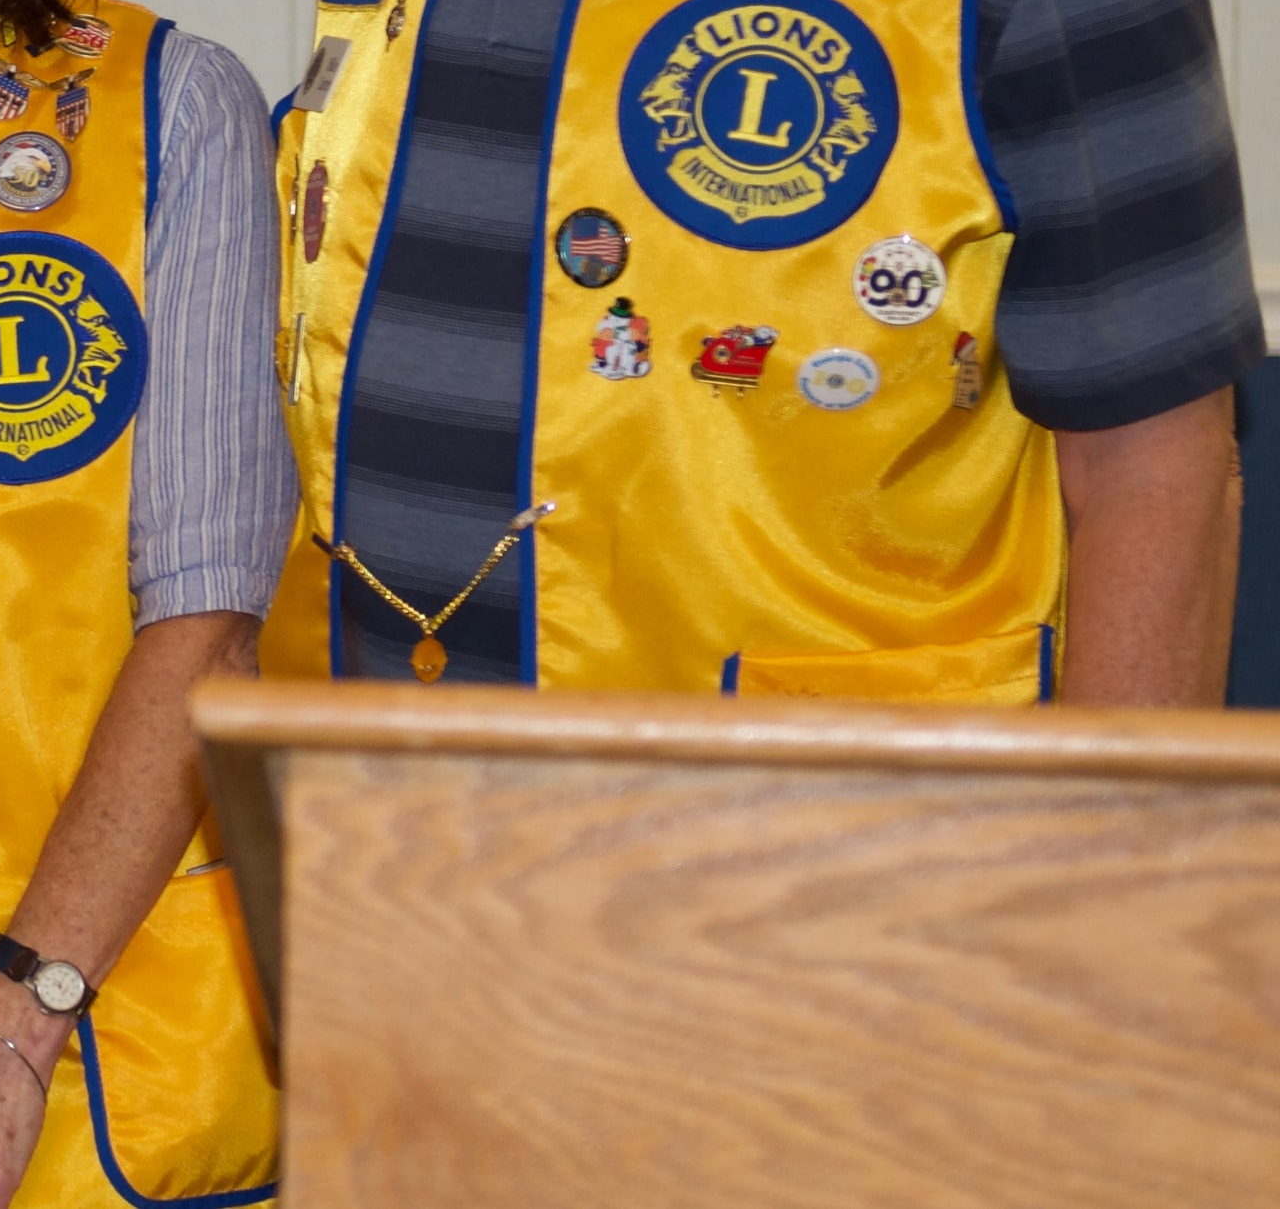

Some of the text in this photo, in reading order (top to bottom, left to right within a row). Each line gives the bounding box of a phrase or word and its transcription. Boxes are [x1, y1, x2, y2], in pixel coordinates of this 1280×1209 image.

[705, 11, 841, 66] LIONS
[726, 68, 794, 149] L
[680, 156, 820, 207] INTERNATIONAL
